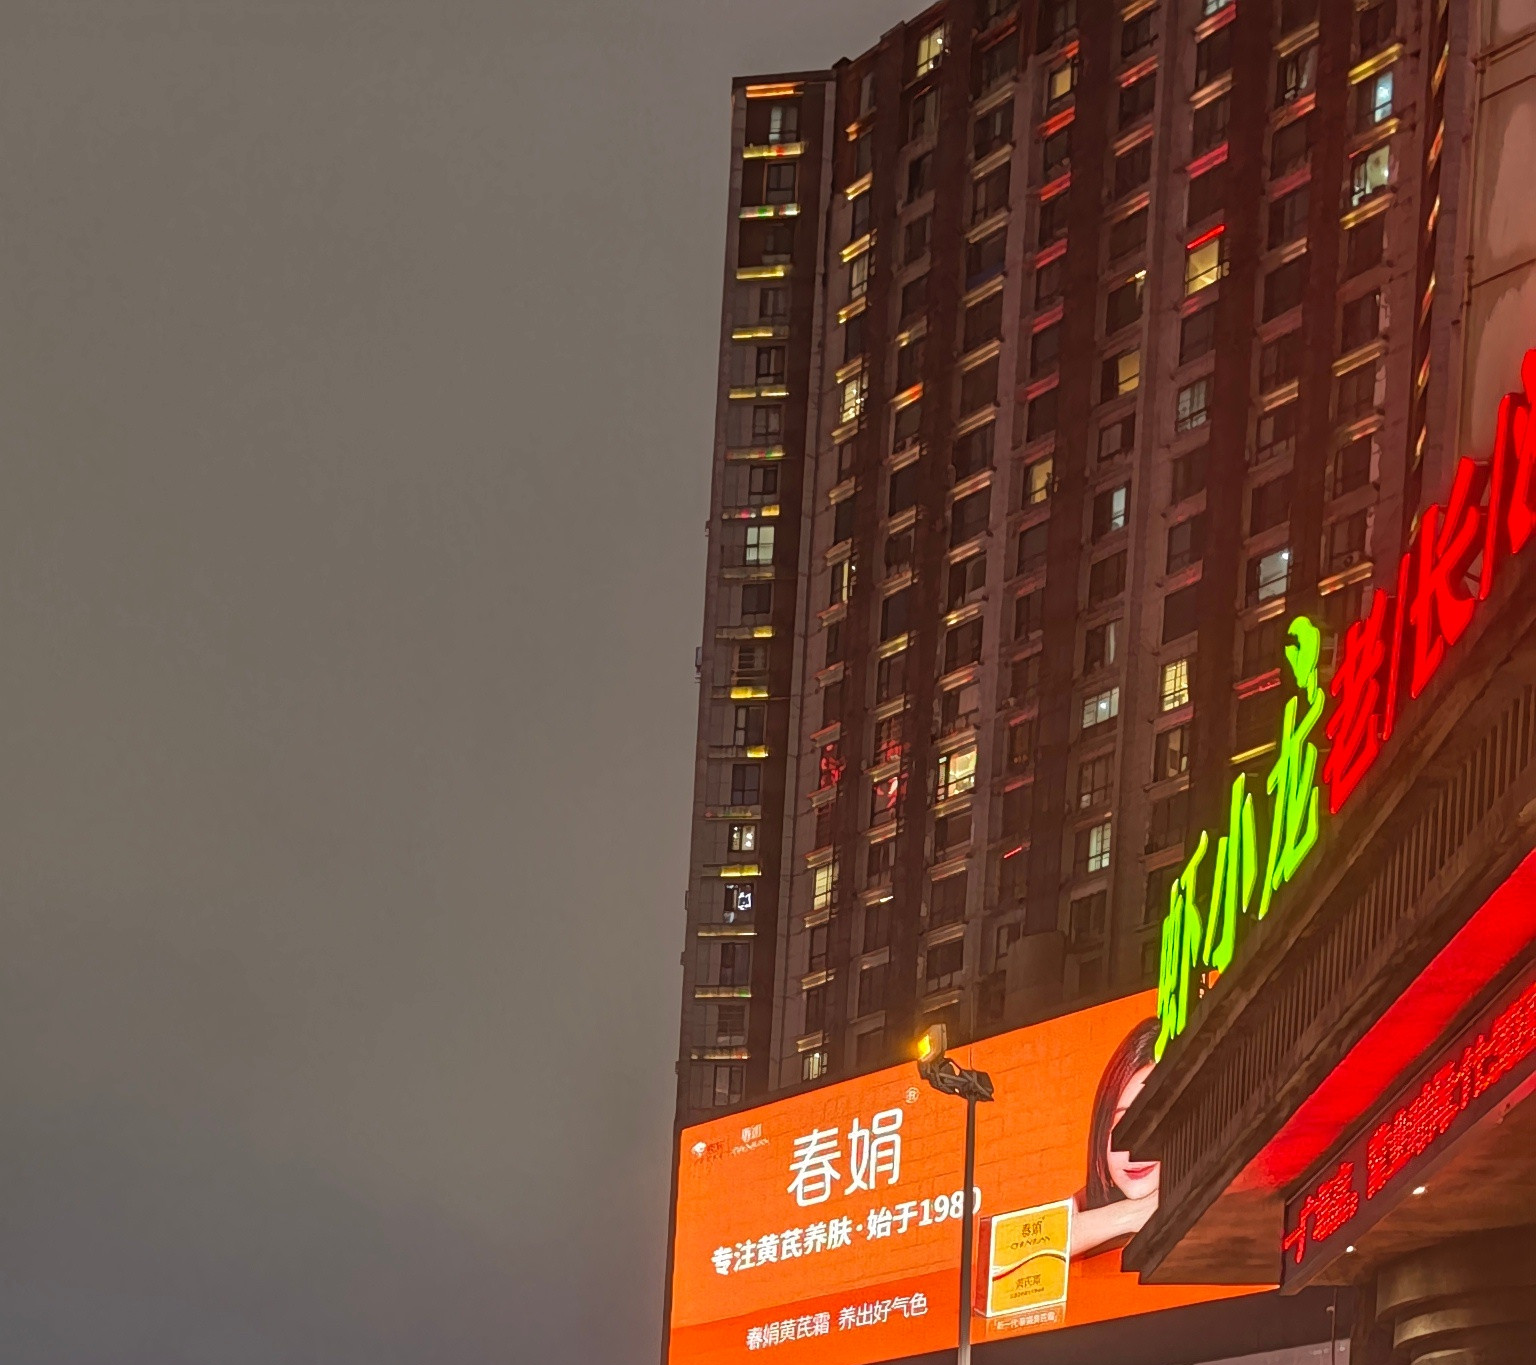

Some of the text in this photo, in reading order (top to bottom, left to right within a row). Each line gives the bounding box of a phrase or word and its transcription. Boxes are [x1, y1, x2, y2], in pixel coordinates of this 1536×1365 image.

[786, 1107, 904, 1208] 春娟
[745, 1292, 929, 1352] 春娟黄芪霜 养出好气色
